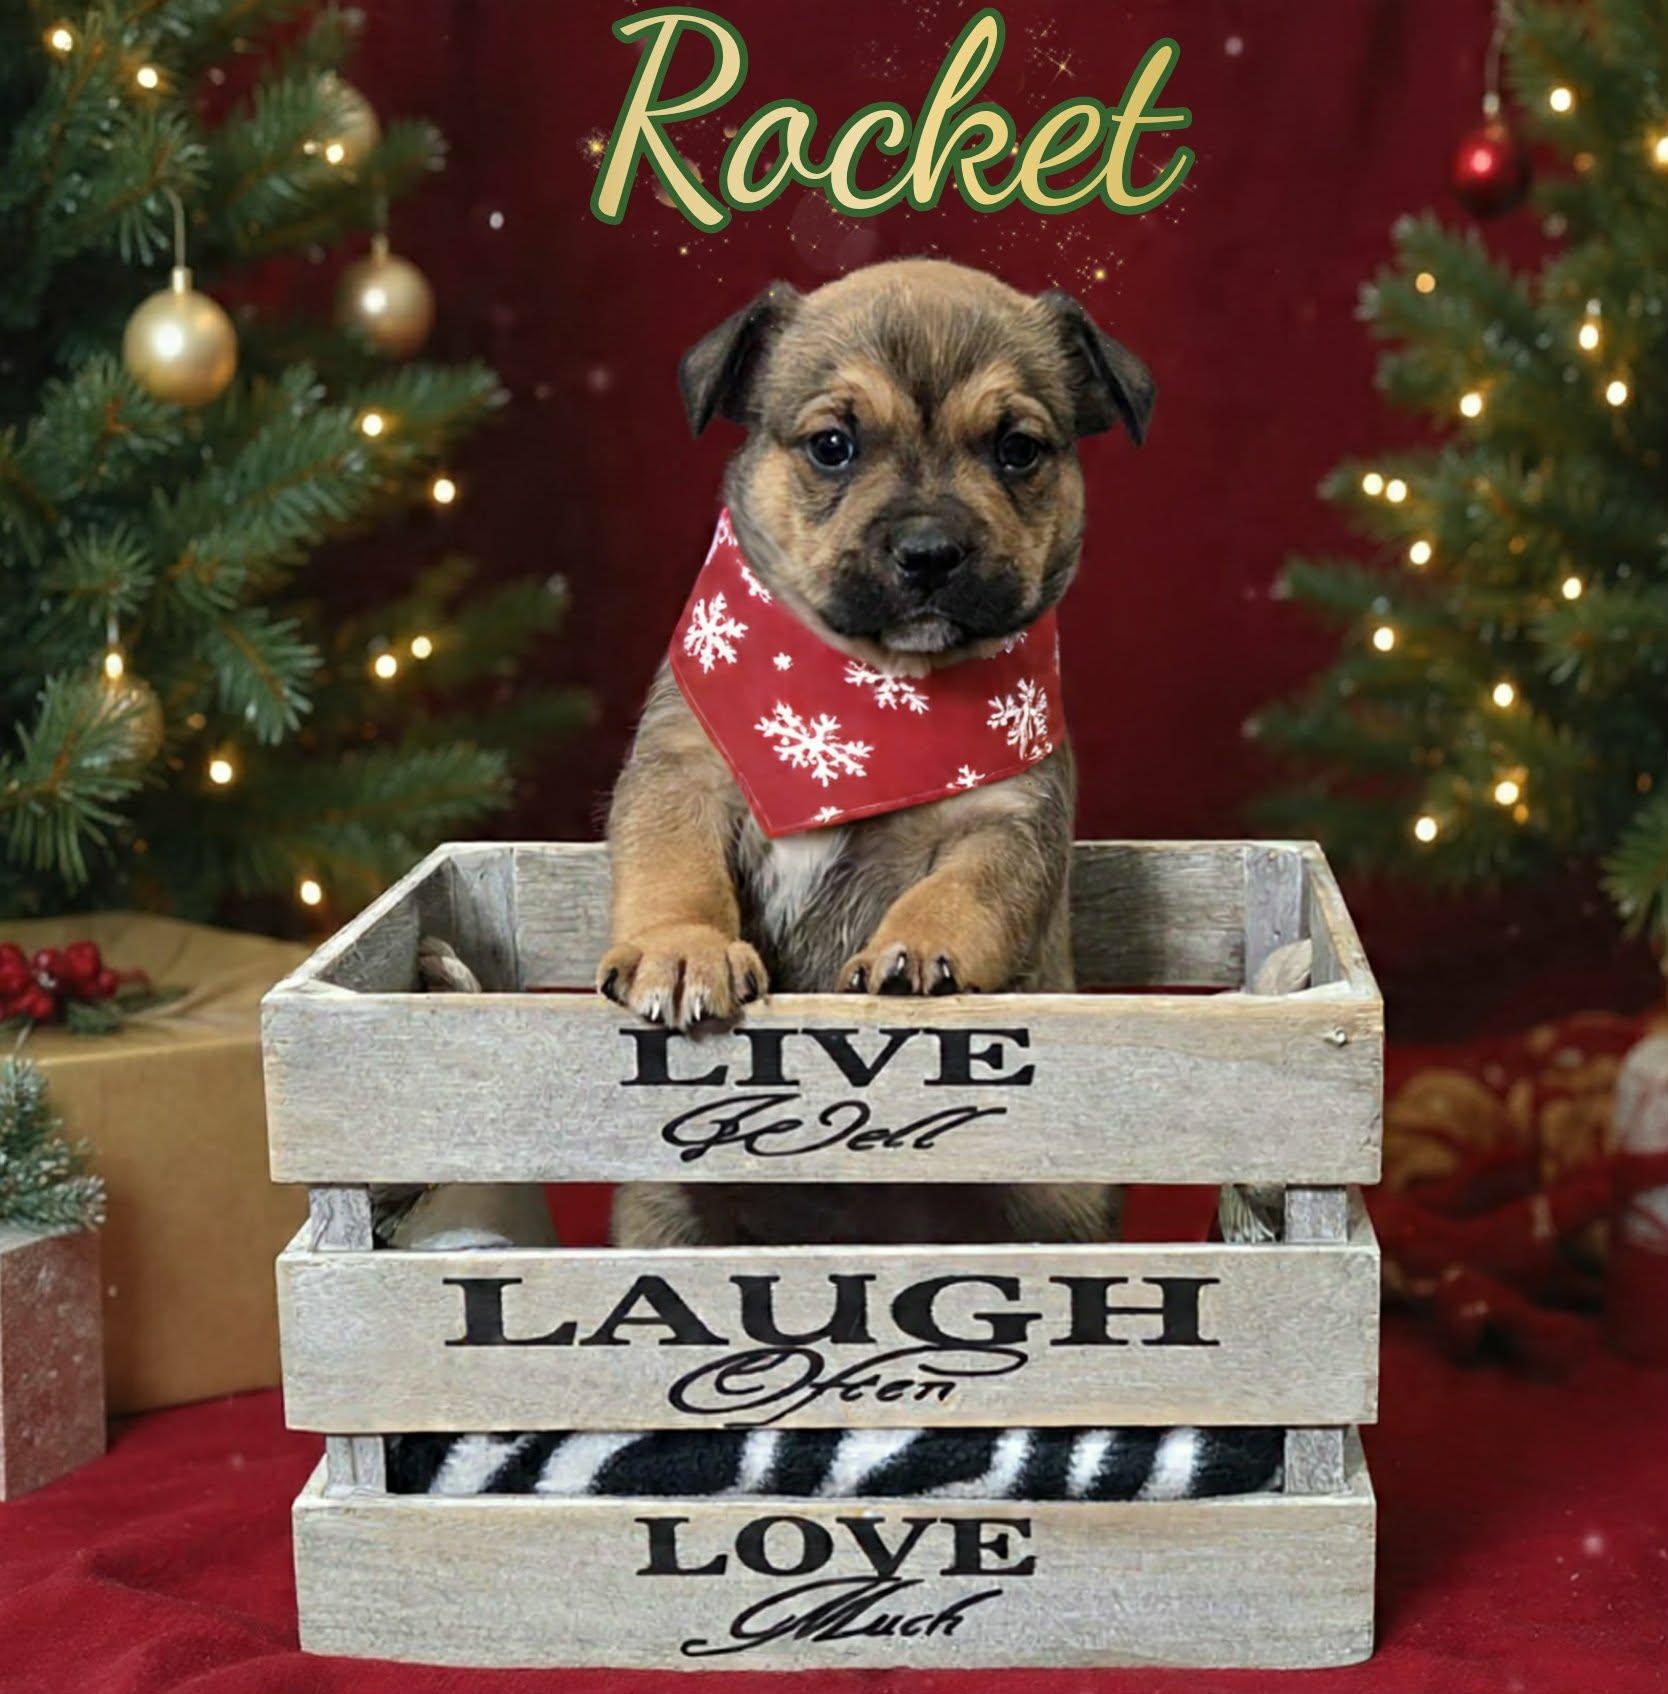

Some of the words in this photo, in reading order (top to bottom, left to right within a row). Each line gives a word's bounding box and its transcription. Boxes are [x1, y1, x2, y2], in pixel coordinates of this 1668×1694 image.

[619, 1027, 1036, 1087] LIVE
[443, 1275, 1221, 1347] LAUGH
[667, 1346, 1029, 1428] Often
[634, 1515, 1037, 1577] LOVE
[680, 1576, 1003, 1657] Much
